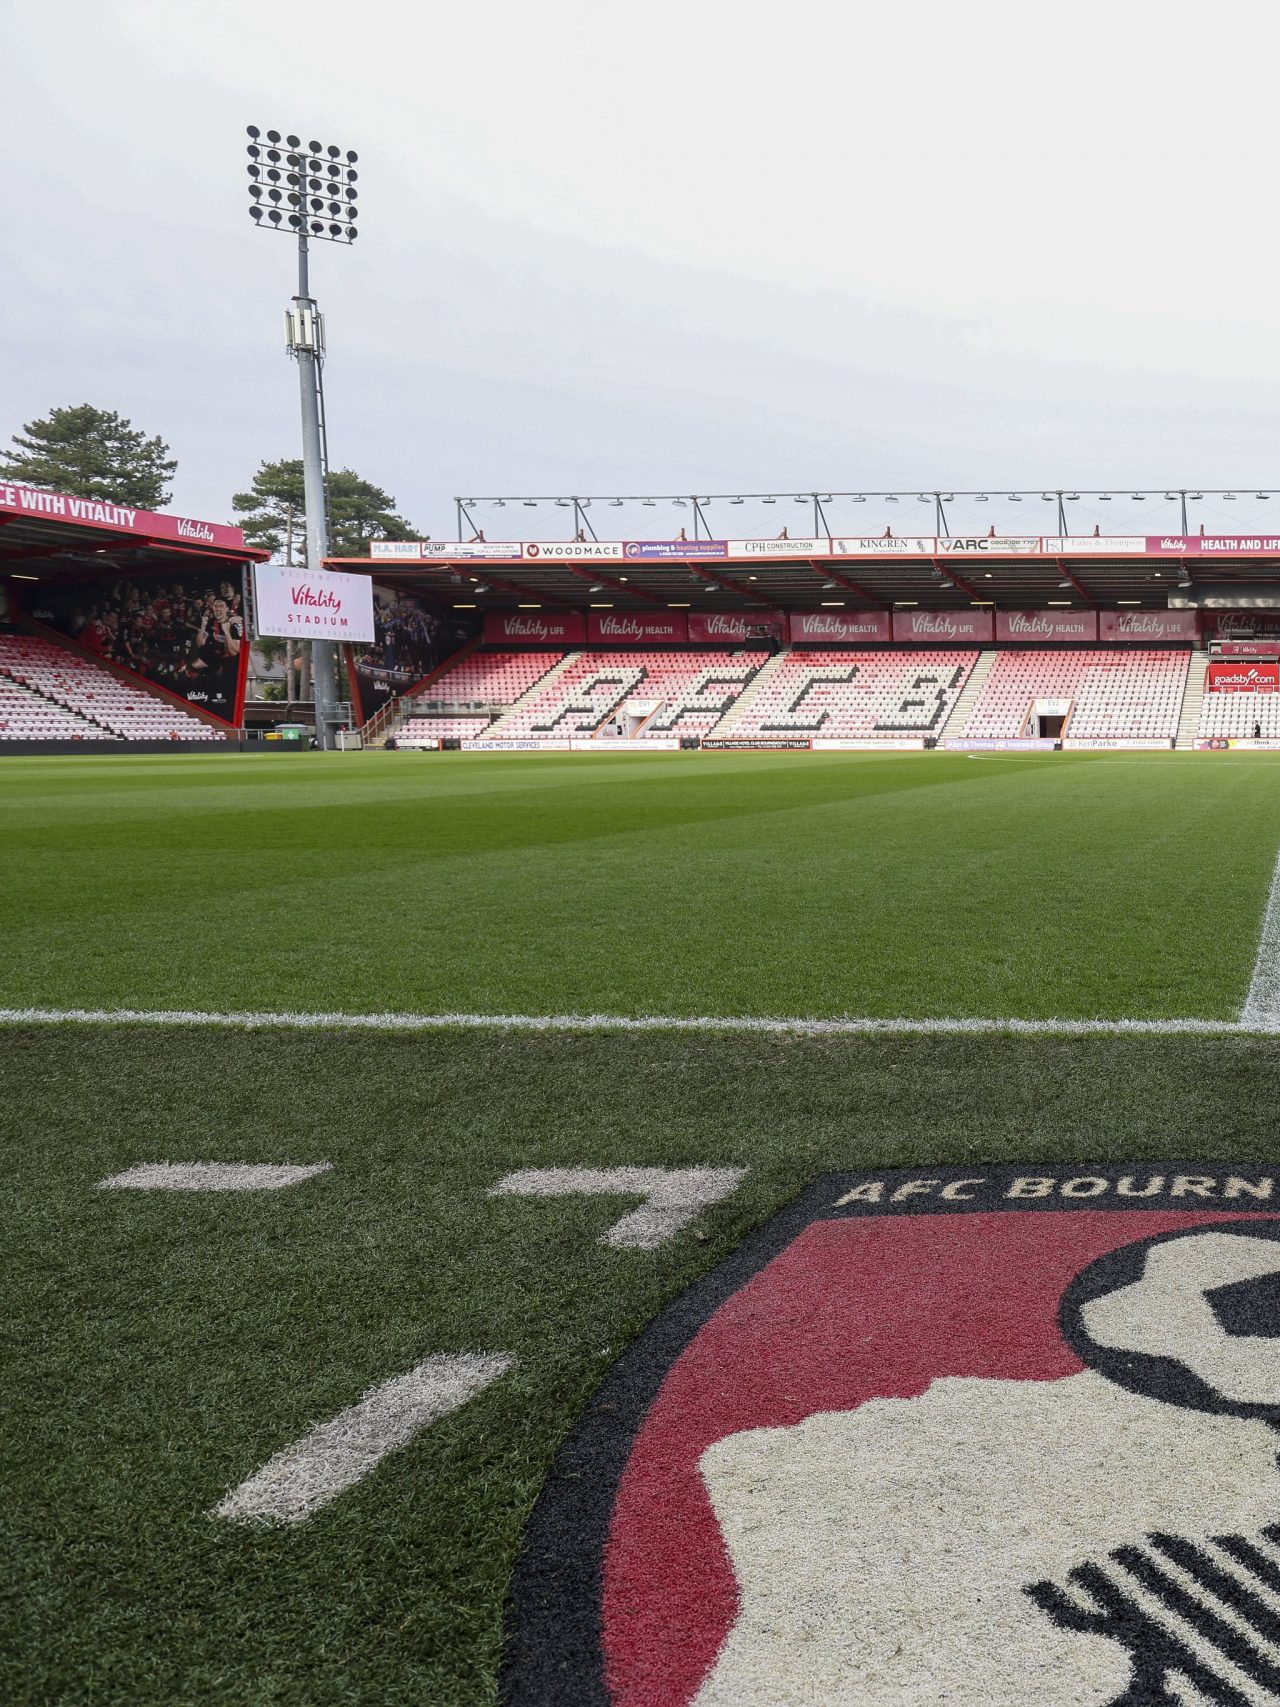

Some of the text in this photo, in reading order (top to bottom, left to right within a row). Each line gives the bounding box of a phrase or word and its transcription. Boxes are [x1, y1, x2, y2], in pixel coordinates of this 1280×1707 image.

[20, 490, 65, 514] WITH
[68, 498, 136, 528] VITALITY
[177, 518, 214, 542] Vitality
[374, 544, 418, 552] M.A. HART
[542, 546, 618, 555] WOODMACE
[745, 542, 766, 552] CPH
[860, 539, 908, 548] KINGREN
[952, 540, 988, 550] ARC
[1161, 538, 1186, 552] Vitality
[1200, 540, 1238, 550] HEALTH
[1240, 540, 1260, 550] AND
[292, 584, 341, 614] Vitality
[288, 614, 348, 626] STADIUM
[504, 616, 548, 640] Vitality
[600, 616, 644, 640] Vitality
[802, 615, 877, 638] Vitality HEALTH
[912, 615, 956, 639] Vitality
[1008, 615, 1084, 639] Vitality HEALTH
[1119, 614, 1181, 638] Vitality LIFE
[187, 690, 208, 702] Vitality
[462, 742, 494, 750] CLEVELAND
[516, 741, 540, 749] SERVICES
[835, 1179, 985, 1207] AFC
